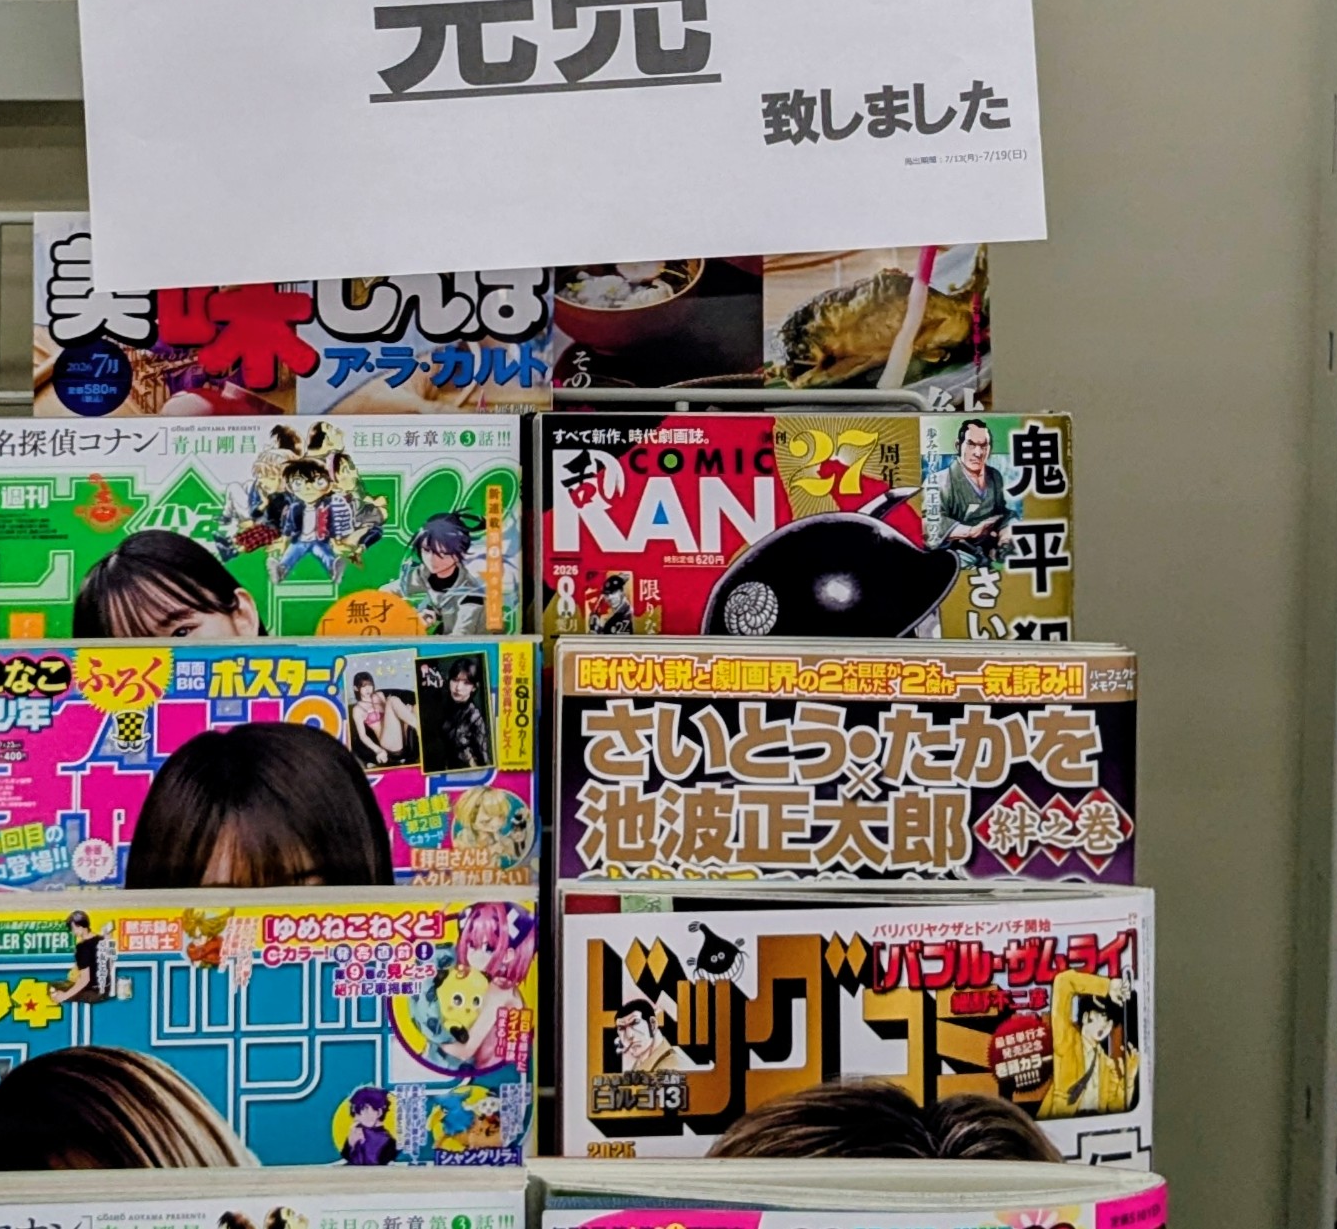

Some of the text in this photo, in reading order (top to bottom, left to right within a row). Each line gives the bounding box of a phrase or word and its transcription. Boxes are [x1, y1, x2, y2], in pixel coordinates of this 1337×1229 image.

[763, 80, 1011, 145] 致しました
[67, 360, 91, 373] 2026
[171, 434, 258, 456] 青山剛昌
[553, 428, 710, 446] すべて新作、時代劇画誌。
[630, 447, 775, 476] COMIC
[789, 429, 879, 499] 27
[1, 485, 50, 510] 週刊
[553, 449, 776, 553] RAN
[553, 565, 579, 575] 2026
[79, 657, 164, 704] ふろく
[176, 661, 205, 676] 両面
[176, 677, 205, 690] BIG
[582, 700, 1102, 786] さいとう・たかを
[576, 782, 974, 872] 池波正太郎
[988, 801, 1125, 857] 絆之巻
[24, 931, 69, 948] SITTER
[873, 918, 1051, 938] バリバリヤクザとドンパチ開始
